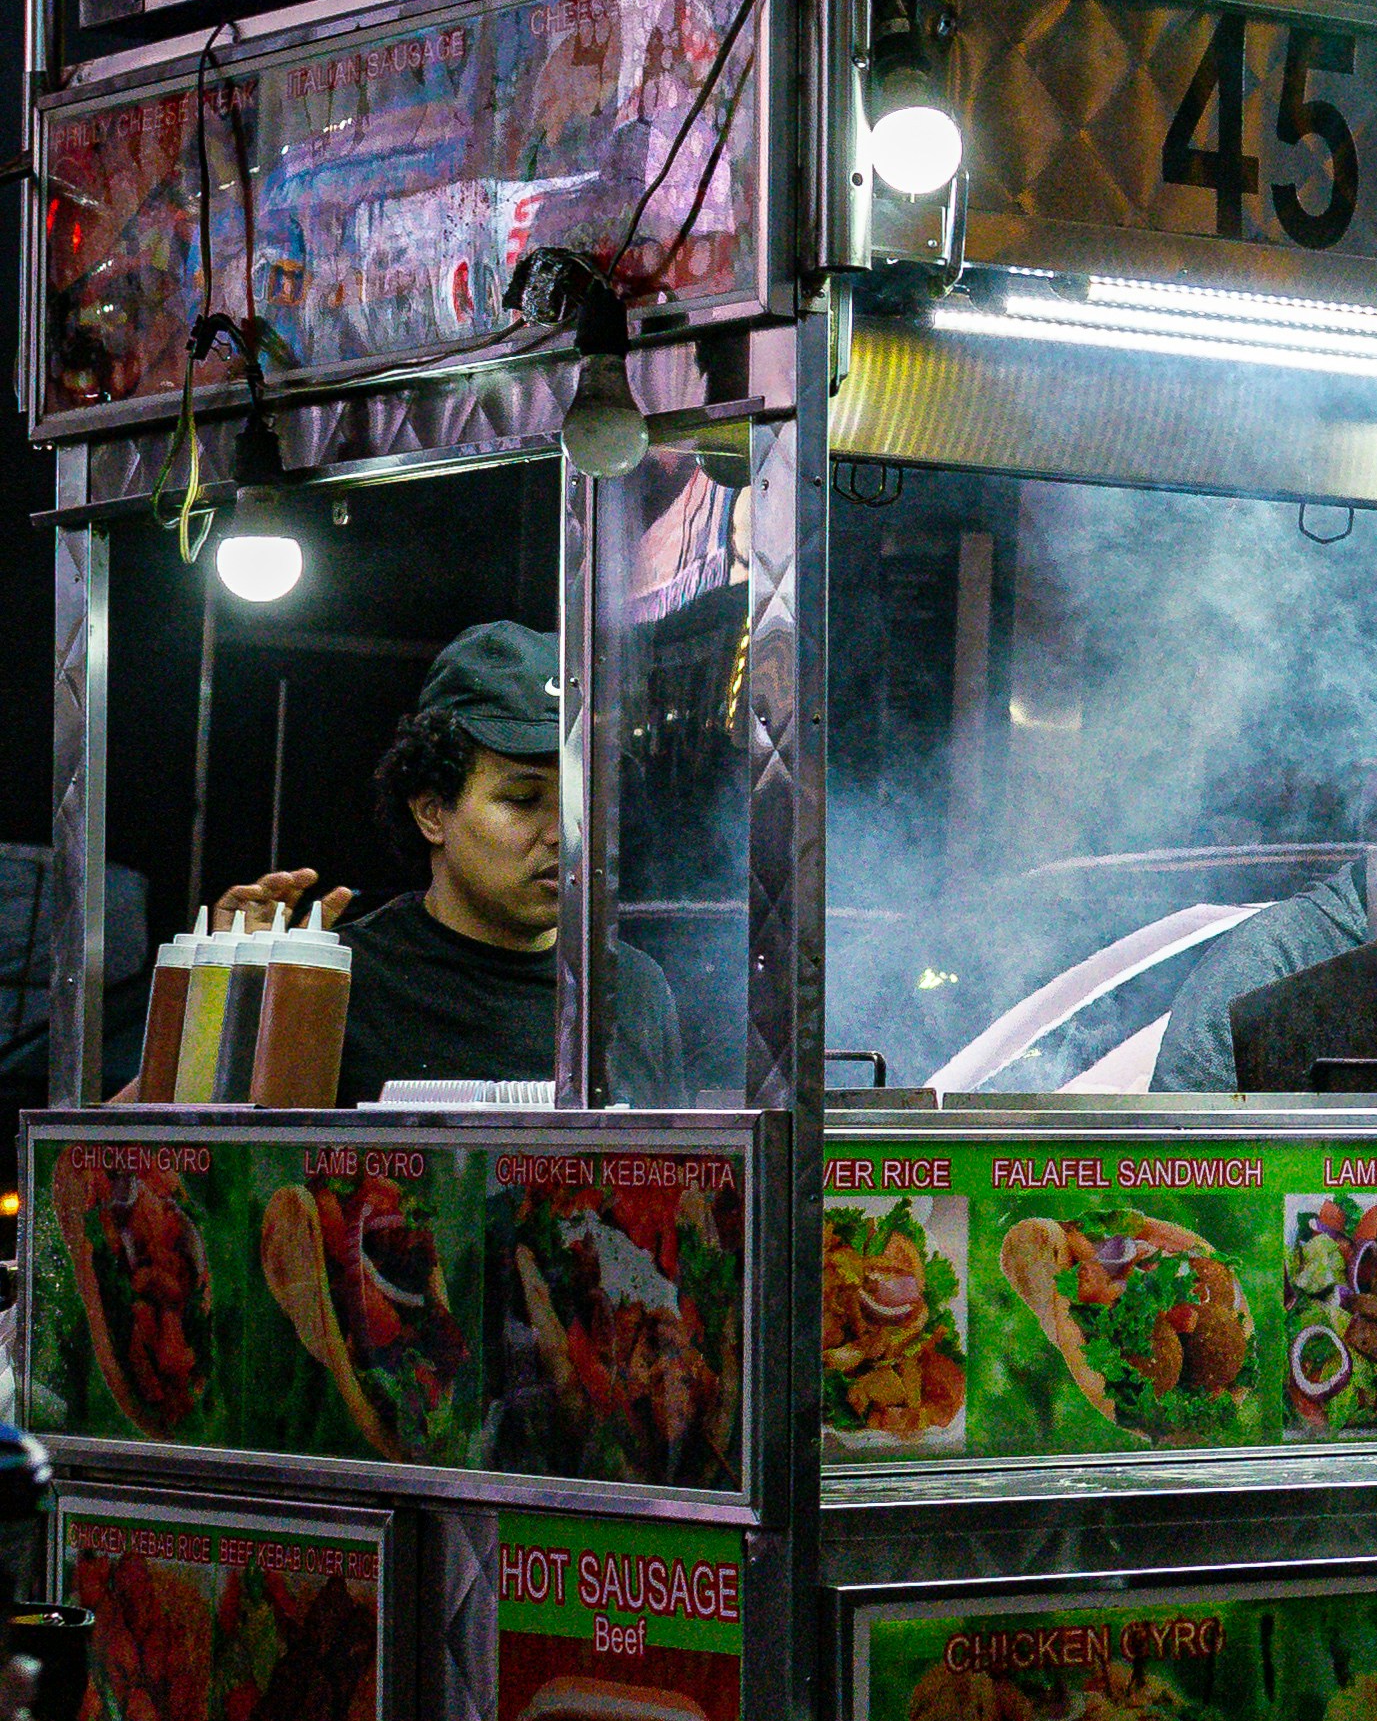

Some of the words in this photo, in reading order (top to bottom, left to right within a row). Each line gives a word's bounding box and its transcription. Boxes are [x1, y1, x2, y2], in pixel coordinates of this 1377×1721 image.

[1161, 10, 1359, 252] 45
[71, 1144, 151, 1171] CHICKEN
[156, 1145, 211, 1173] GYRO
[304, 1147, 361, 1177] LAMB
[365, 1151, 425, 1180] GYRO
[496, 1154, 593, 1185] CHICKEN
[602, 1157, 679, 1187] KEBAB
[684, 1160, 735, 1190] PITA
[882, 1160, 951, 1189] RICE
[993, 1160, 1111, 1189] FALAFEL
[1118, 1160, 1263, 1188] SANDWICH
[131, 1528, 173, 1557] KEBAB
[178, 1533, 210, 1561] RICE
[220, 1537, 252, 1564] BEEF
[256, 1543, 300, 1571] KEBAB
[305, 1546, 343, 1575] OVER
[501, 1543, 569, 1594] HOT
[579, 1550, 739, 1620] SAUSAGE
[594, 1615, 646, 1657] Beef
[945, 1631, 1112, 1675] CHICKEN
